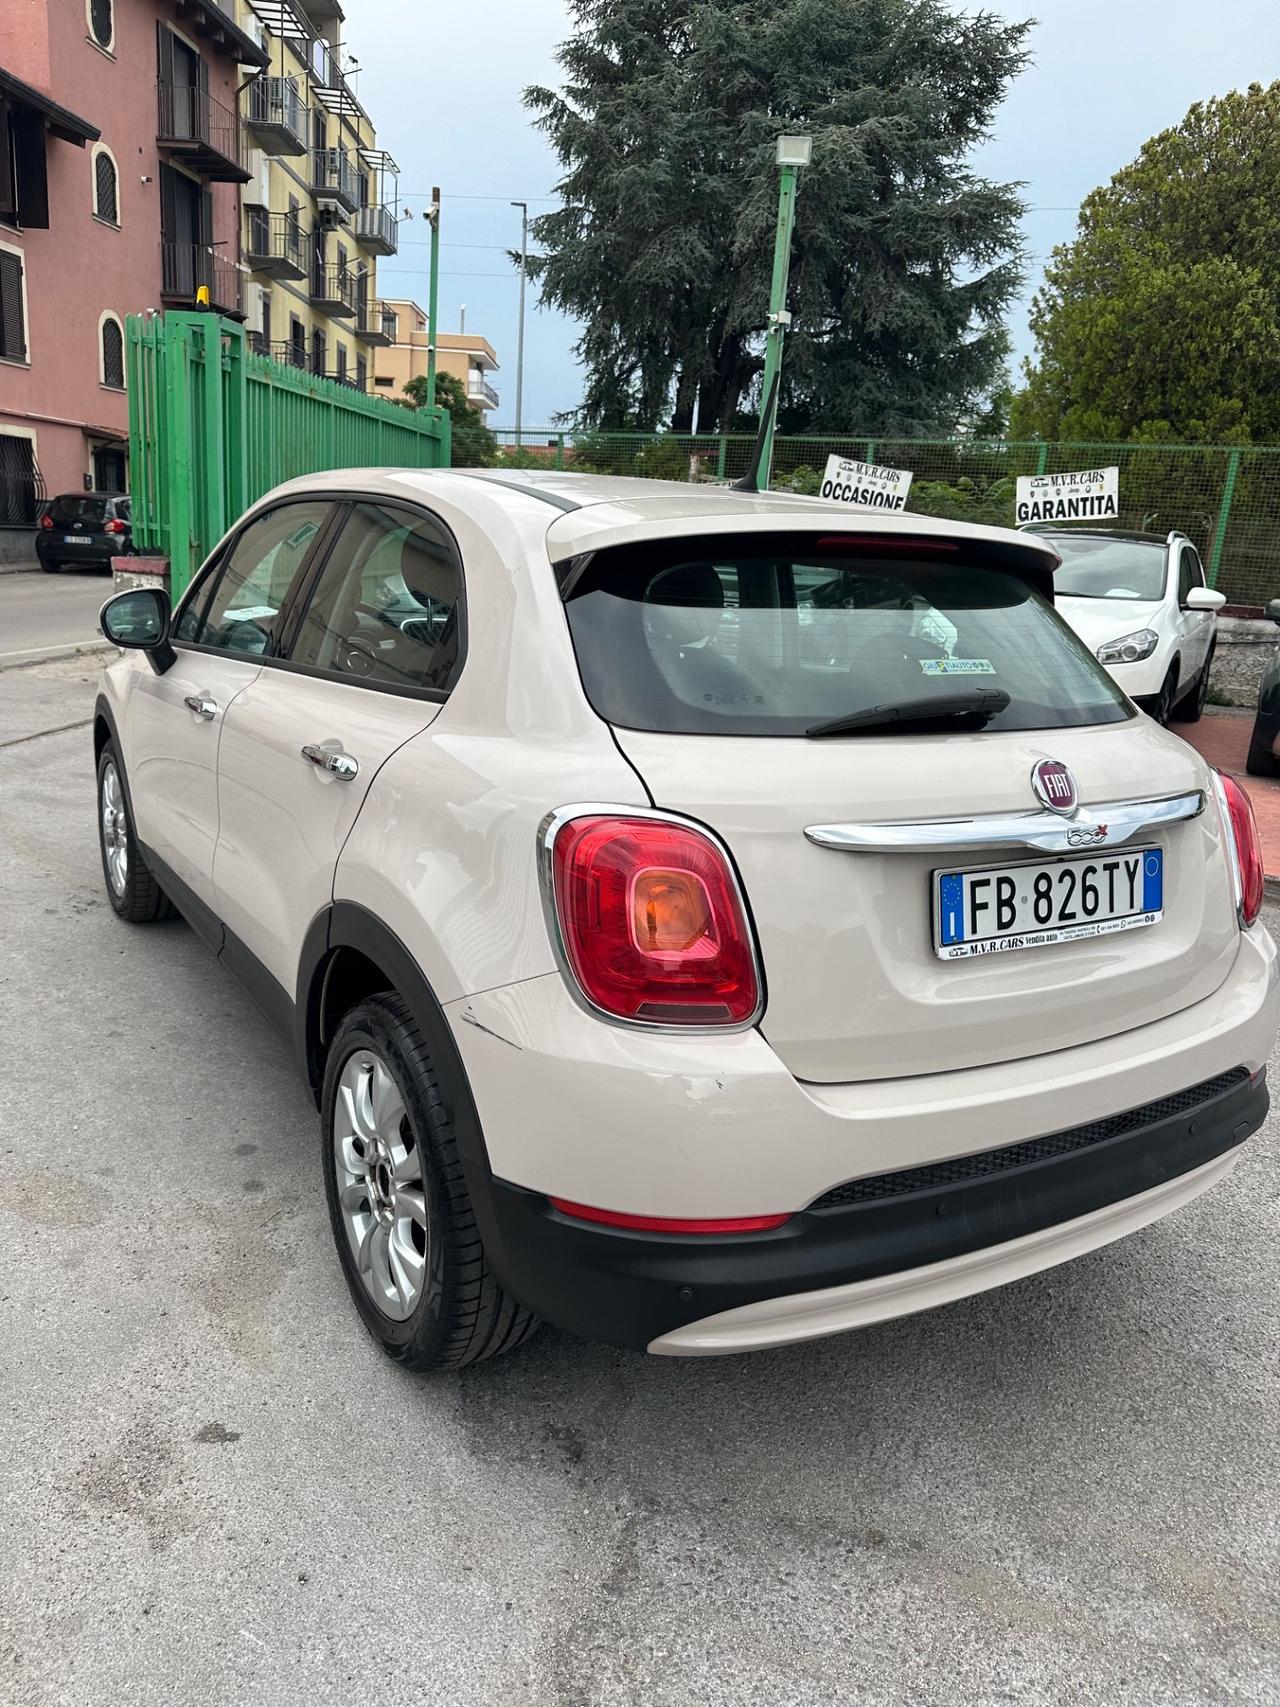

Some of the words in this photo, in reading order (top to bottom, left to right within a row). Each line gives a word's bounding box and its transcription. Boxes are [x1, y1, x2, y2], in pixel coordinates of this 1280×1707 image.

[822, 480, 905, 511] OCCASIONE
[1017, 494, 1117, 522] GARANTITA
[1043, 773, 1071, 799] FIAT
[969, 875, 1017, 935] FB
[1033, 858, 1140, 925] 826TY
